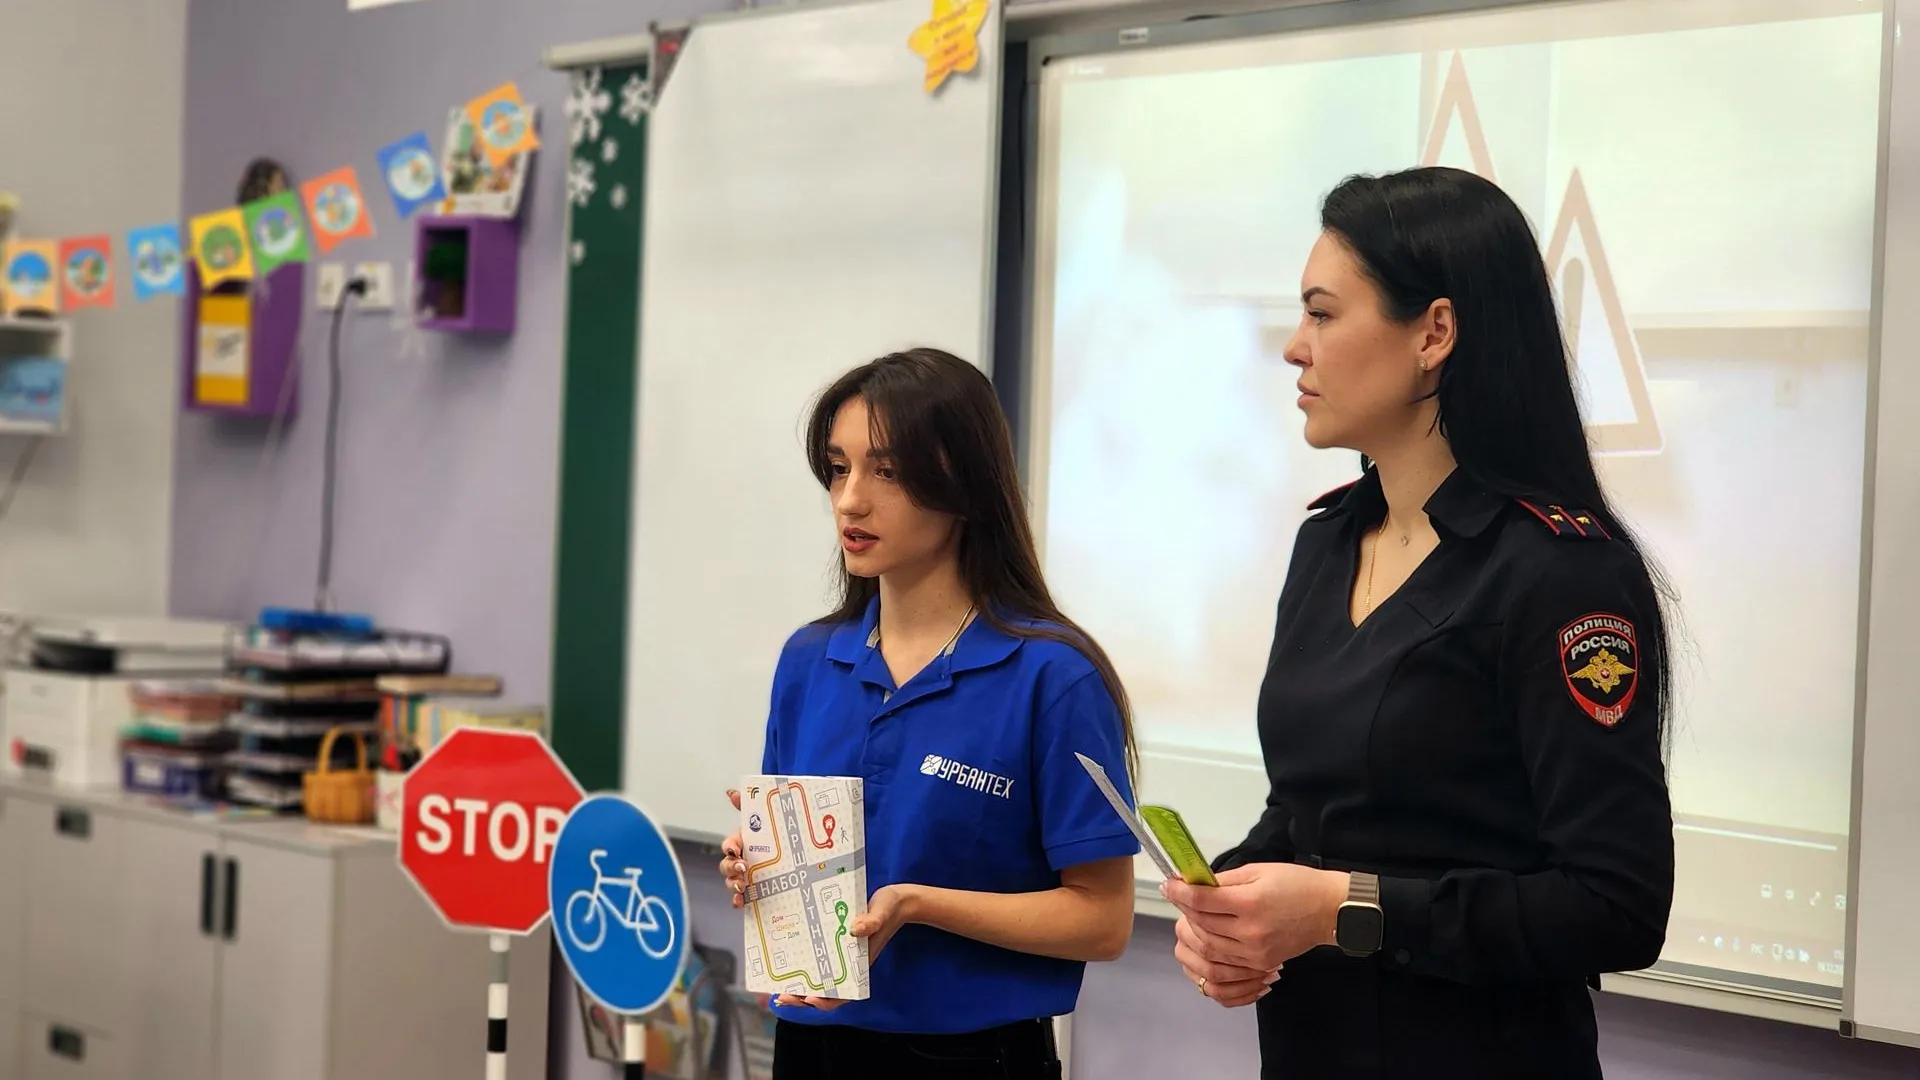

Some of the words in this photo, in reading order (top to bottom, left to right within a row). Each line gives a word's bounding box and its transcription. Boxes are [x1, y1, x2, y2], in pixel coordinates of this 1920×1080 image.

[1563, 618, 1632, 645] ПОЛИЦИЯ
[1570, 635, 1631, 660] РОССИЯ
[1595, 704, 1623, 724] МВД
[937, 757, 1015, 799] УРБАНТЕХ
[415, 793, 566, 864] STOP
[760, 869, 808, 897] НАБОР
